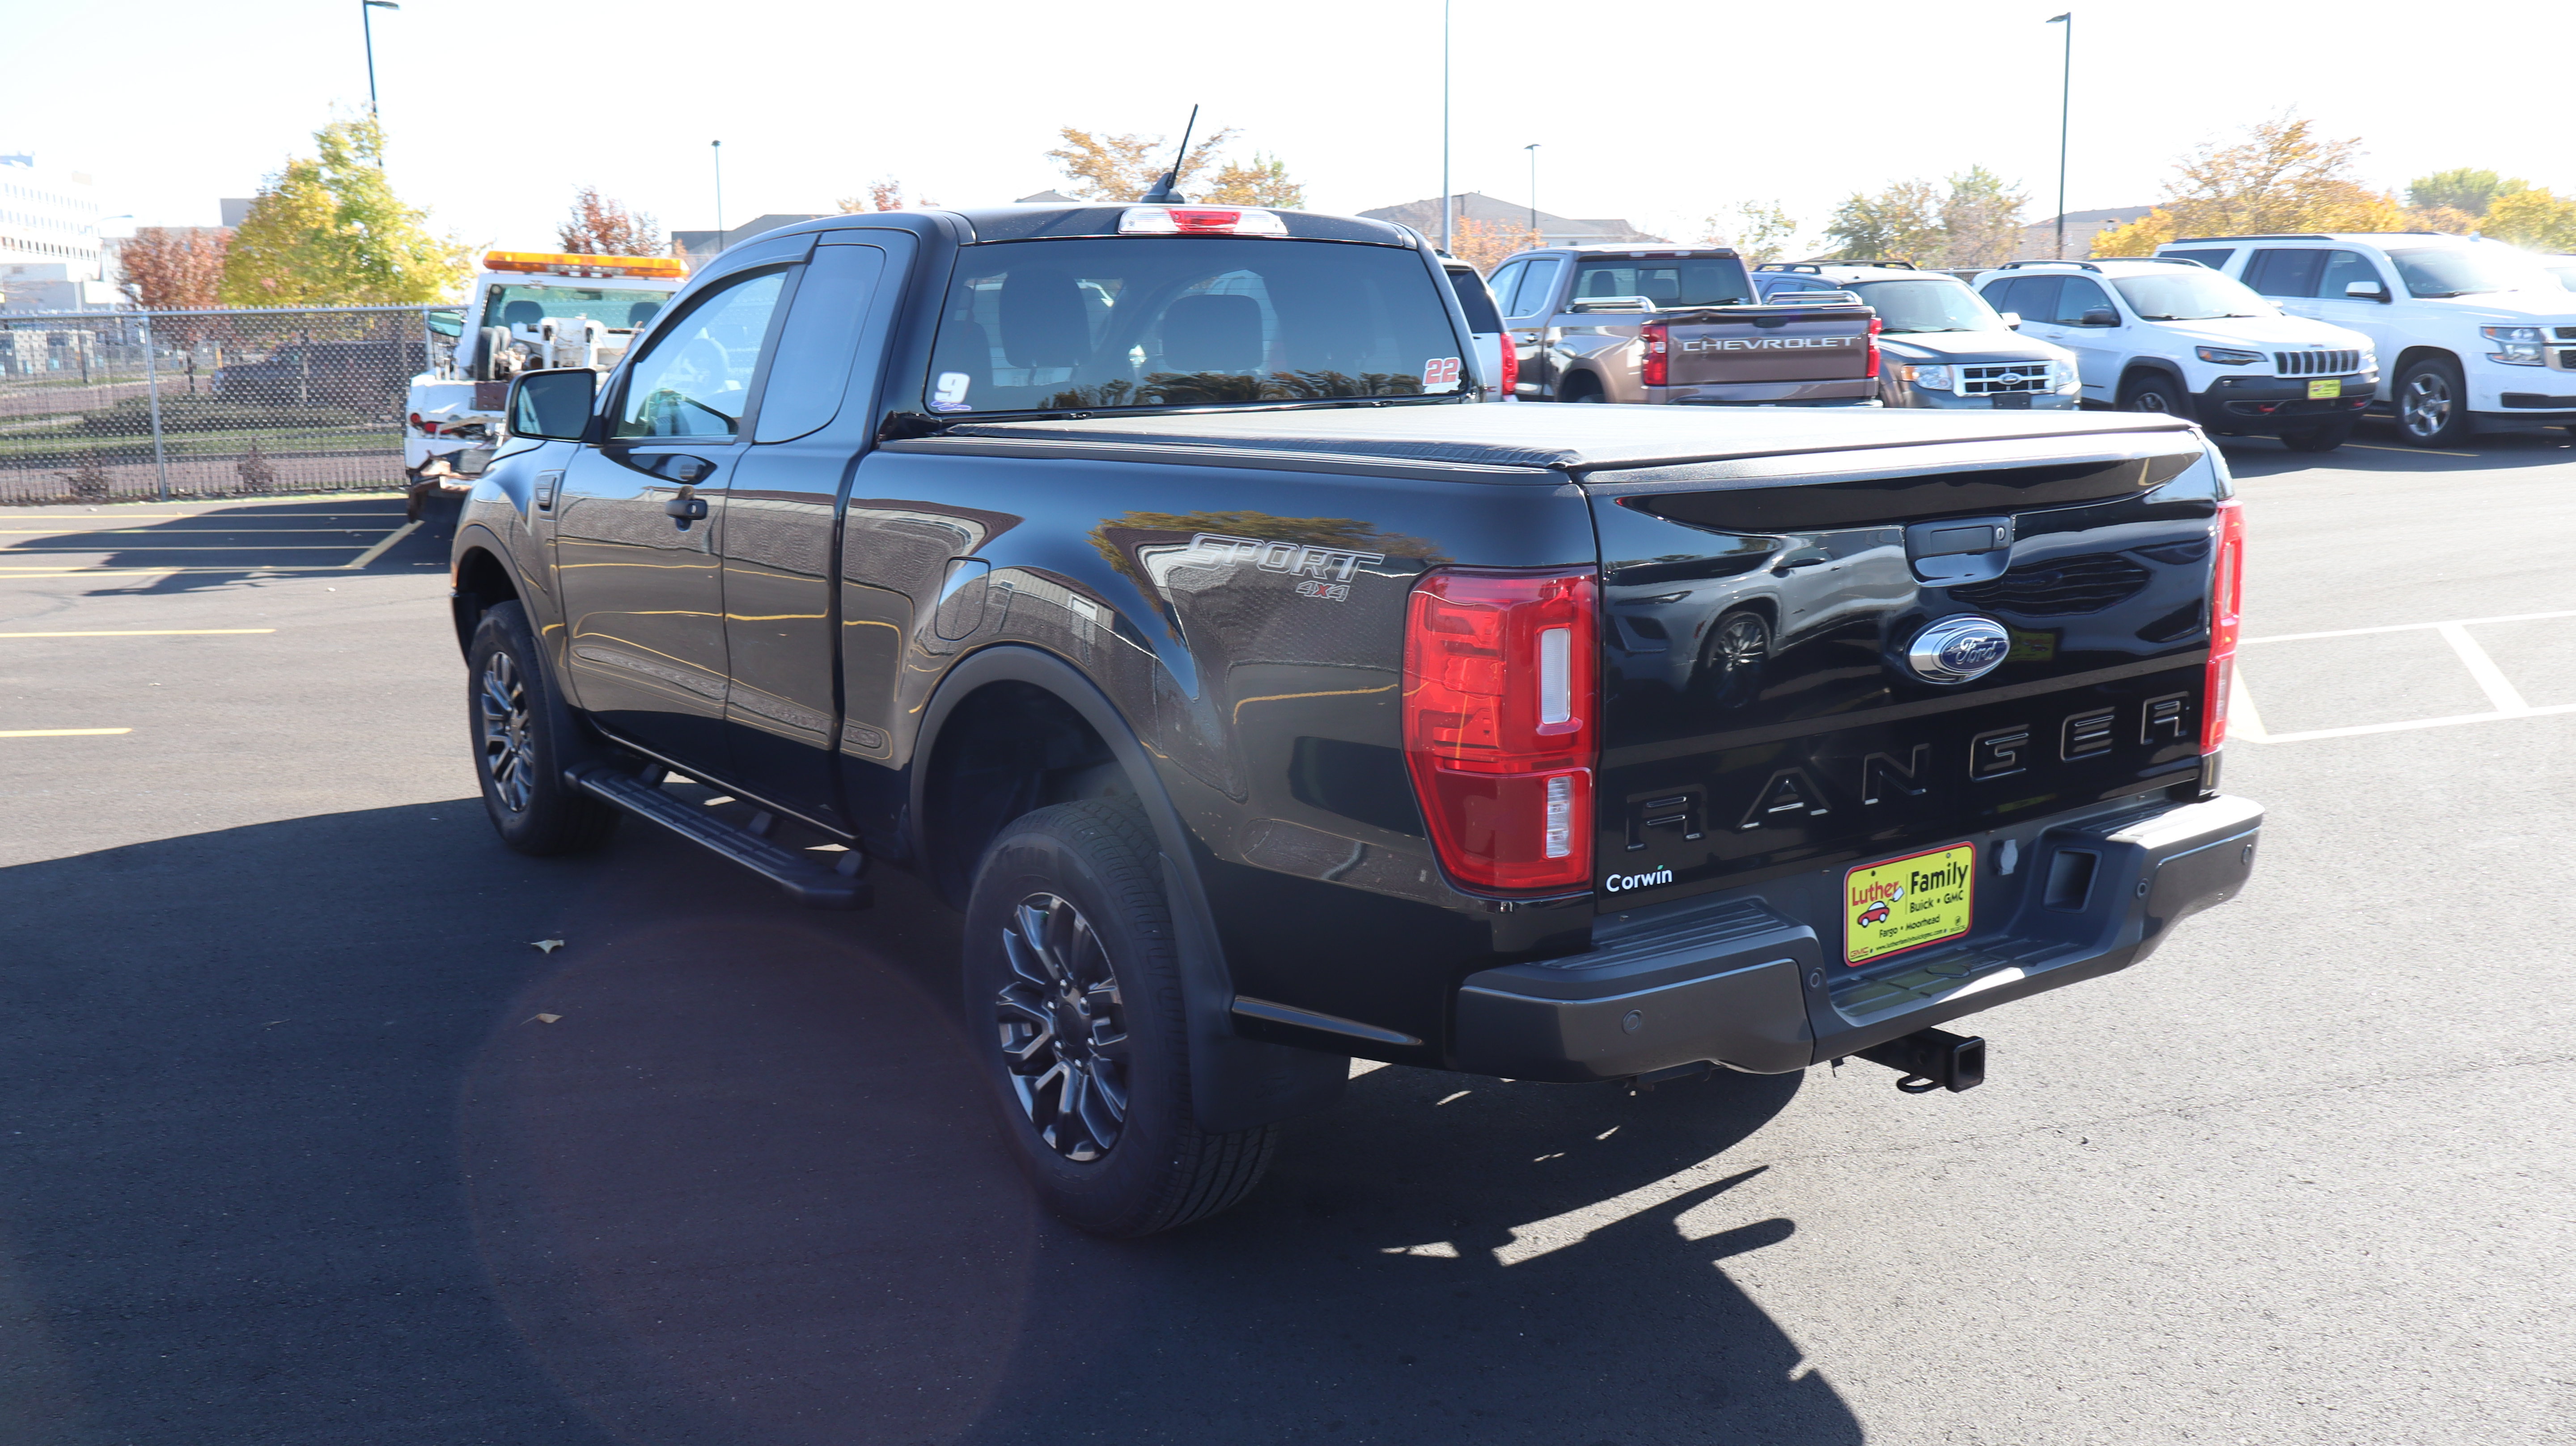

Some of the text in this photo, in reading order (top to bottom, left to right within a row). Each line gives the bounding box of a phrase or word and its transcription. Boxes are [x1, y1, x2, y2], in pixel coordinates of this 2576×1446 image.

[1683, 336, 1855, 352] CHEVROLET
[1424, 358, 1460, 385] 22
[935, 372, 970, 403] 9
[1169, 532, 1385, 583] SPORT
[1955, 636, 1997, 665] Ford
[1625, 691, 2190, 851] RANGER
[1606, 865, 1673, 892] Corwin
[1911, 861, 1969, 895] Family
[1852, 881, 1899, 906] Luther
[1910, 890, 1963, 913] Buick GMC
[1879, 914, 1940, 938] Fargo Moorhead
